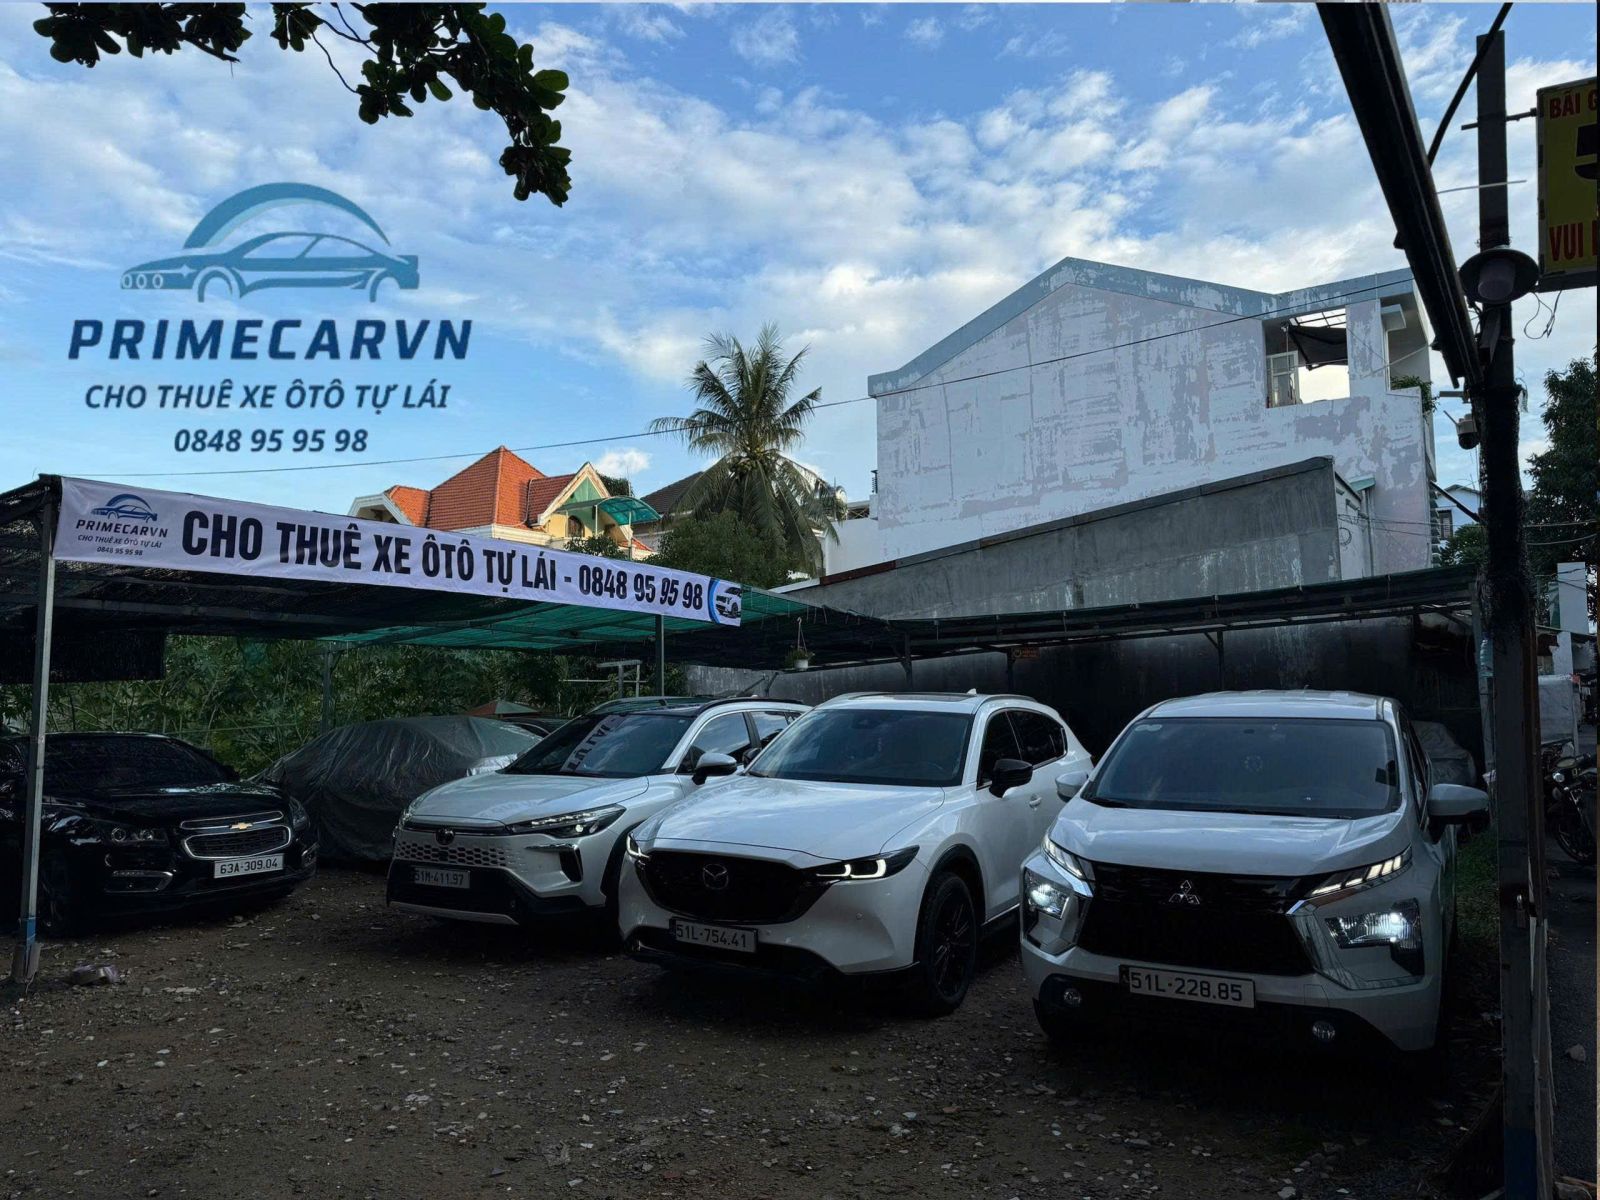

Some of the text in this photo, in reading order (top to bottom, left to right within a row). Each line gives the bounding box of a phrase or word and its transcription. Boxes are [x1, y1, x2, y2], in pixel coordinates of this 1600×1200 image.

[1549, 222, 1584, 261] VUI
[75, 519, 169, 538] PRIMECARVN
[77, 534, 94, 542] CHO
[181, 510, 264, 561] CHO
[276, 523, 362, 571] THUÊ
[372, 533, 412, 575] XE
[421, 533, 474, 581] ÔTÔ
[482, 548, 516, 593] TỰ
[521, 551, 557, 591] LÁI
[578, 564, 628, 600] 0848
[633, 573, 656, 604] 95
[659, 577, 680, 607] 95
[682, 581, 704, 611] 98
